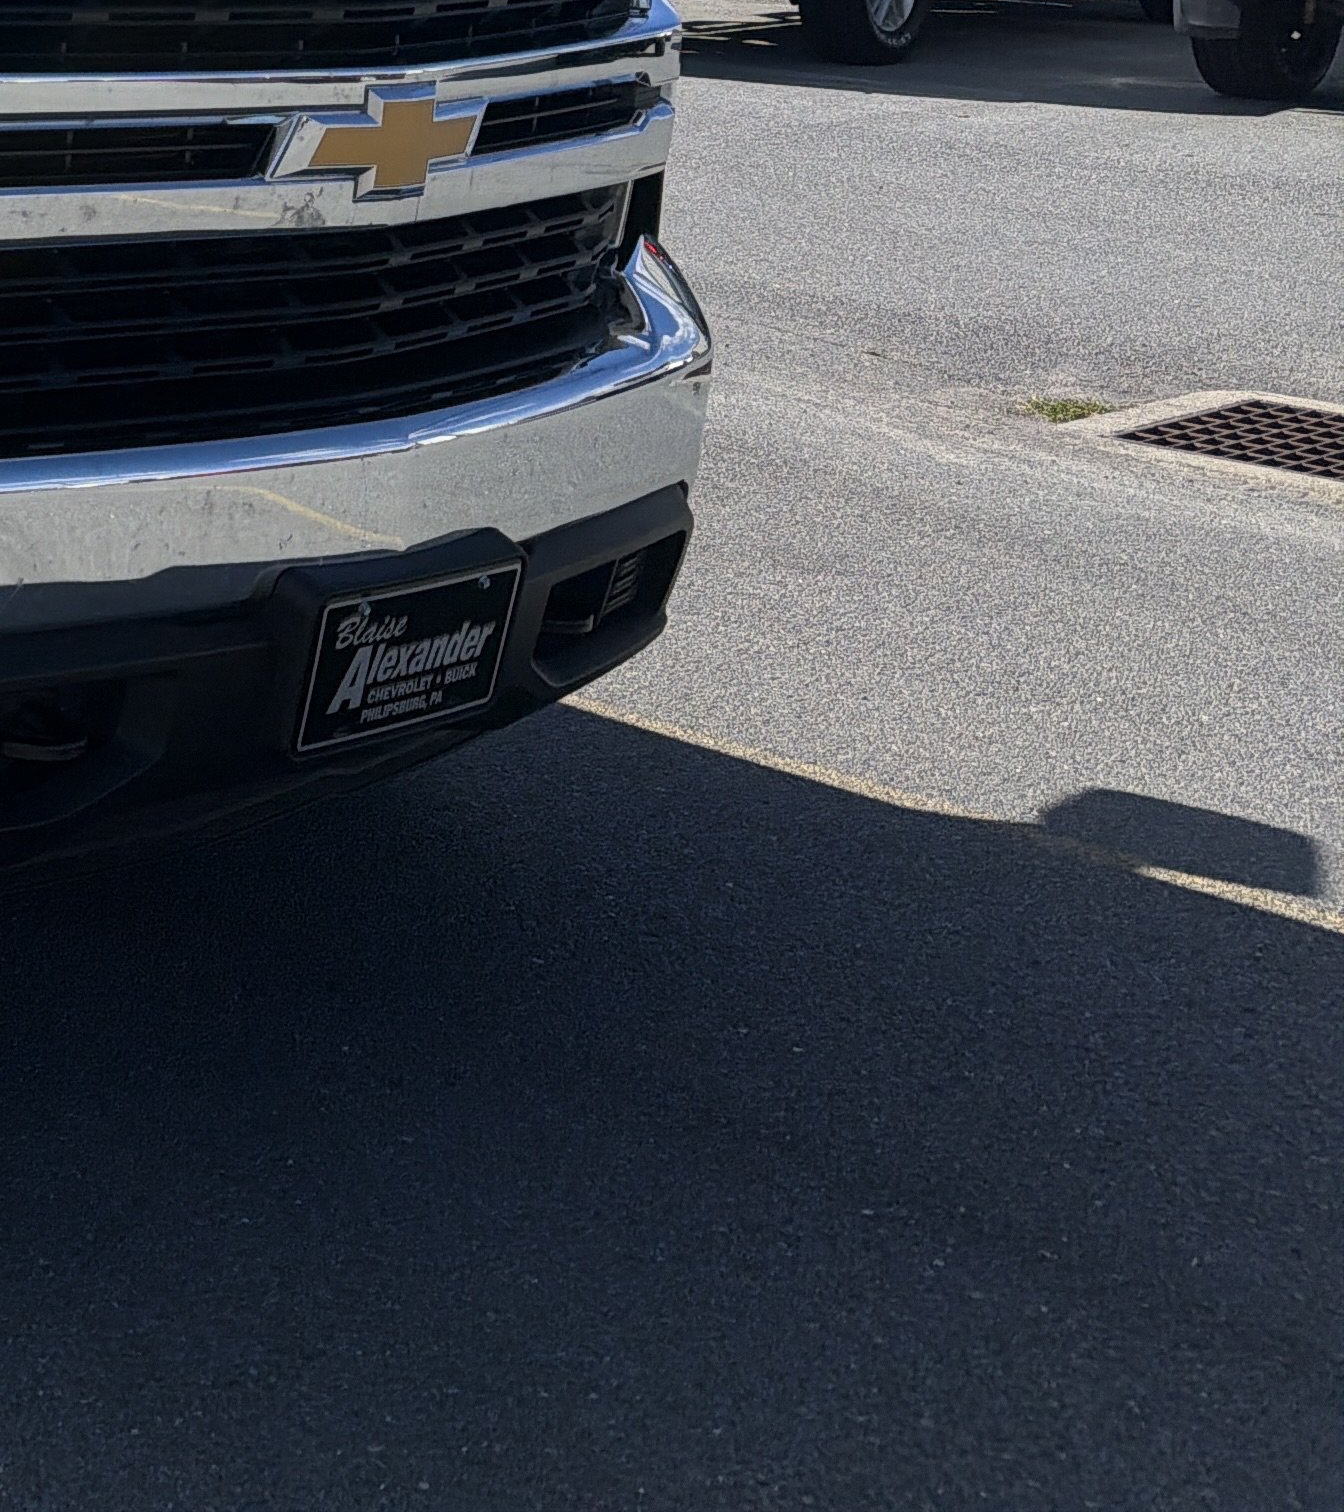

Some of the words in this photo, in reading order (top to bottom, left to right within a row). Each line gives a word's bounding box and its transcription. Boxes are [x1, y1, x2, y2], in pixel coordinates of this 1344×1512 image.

[335, 614, 409, 651] Blaise
[326, 619, 496, 715] Alexander
[367, 675, 433, 704] CHEVROLET
[444, 661, 479, 686] BUICK
[360, 694, 428, 724] PHILIPSBURG,
[429, 689, 443, 705] PA
